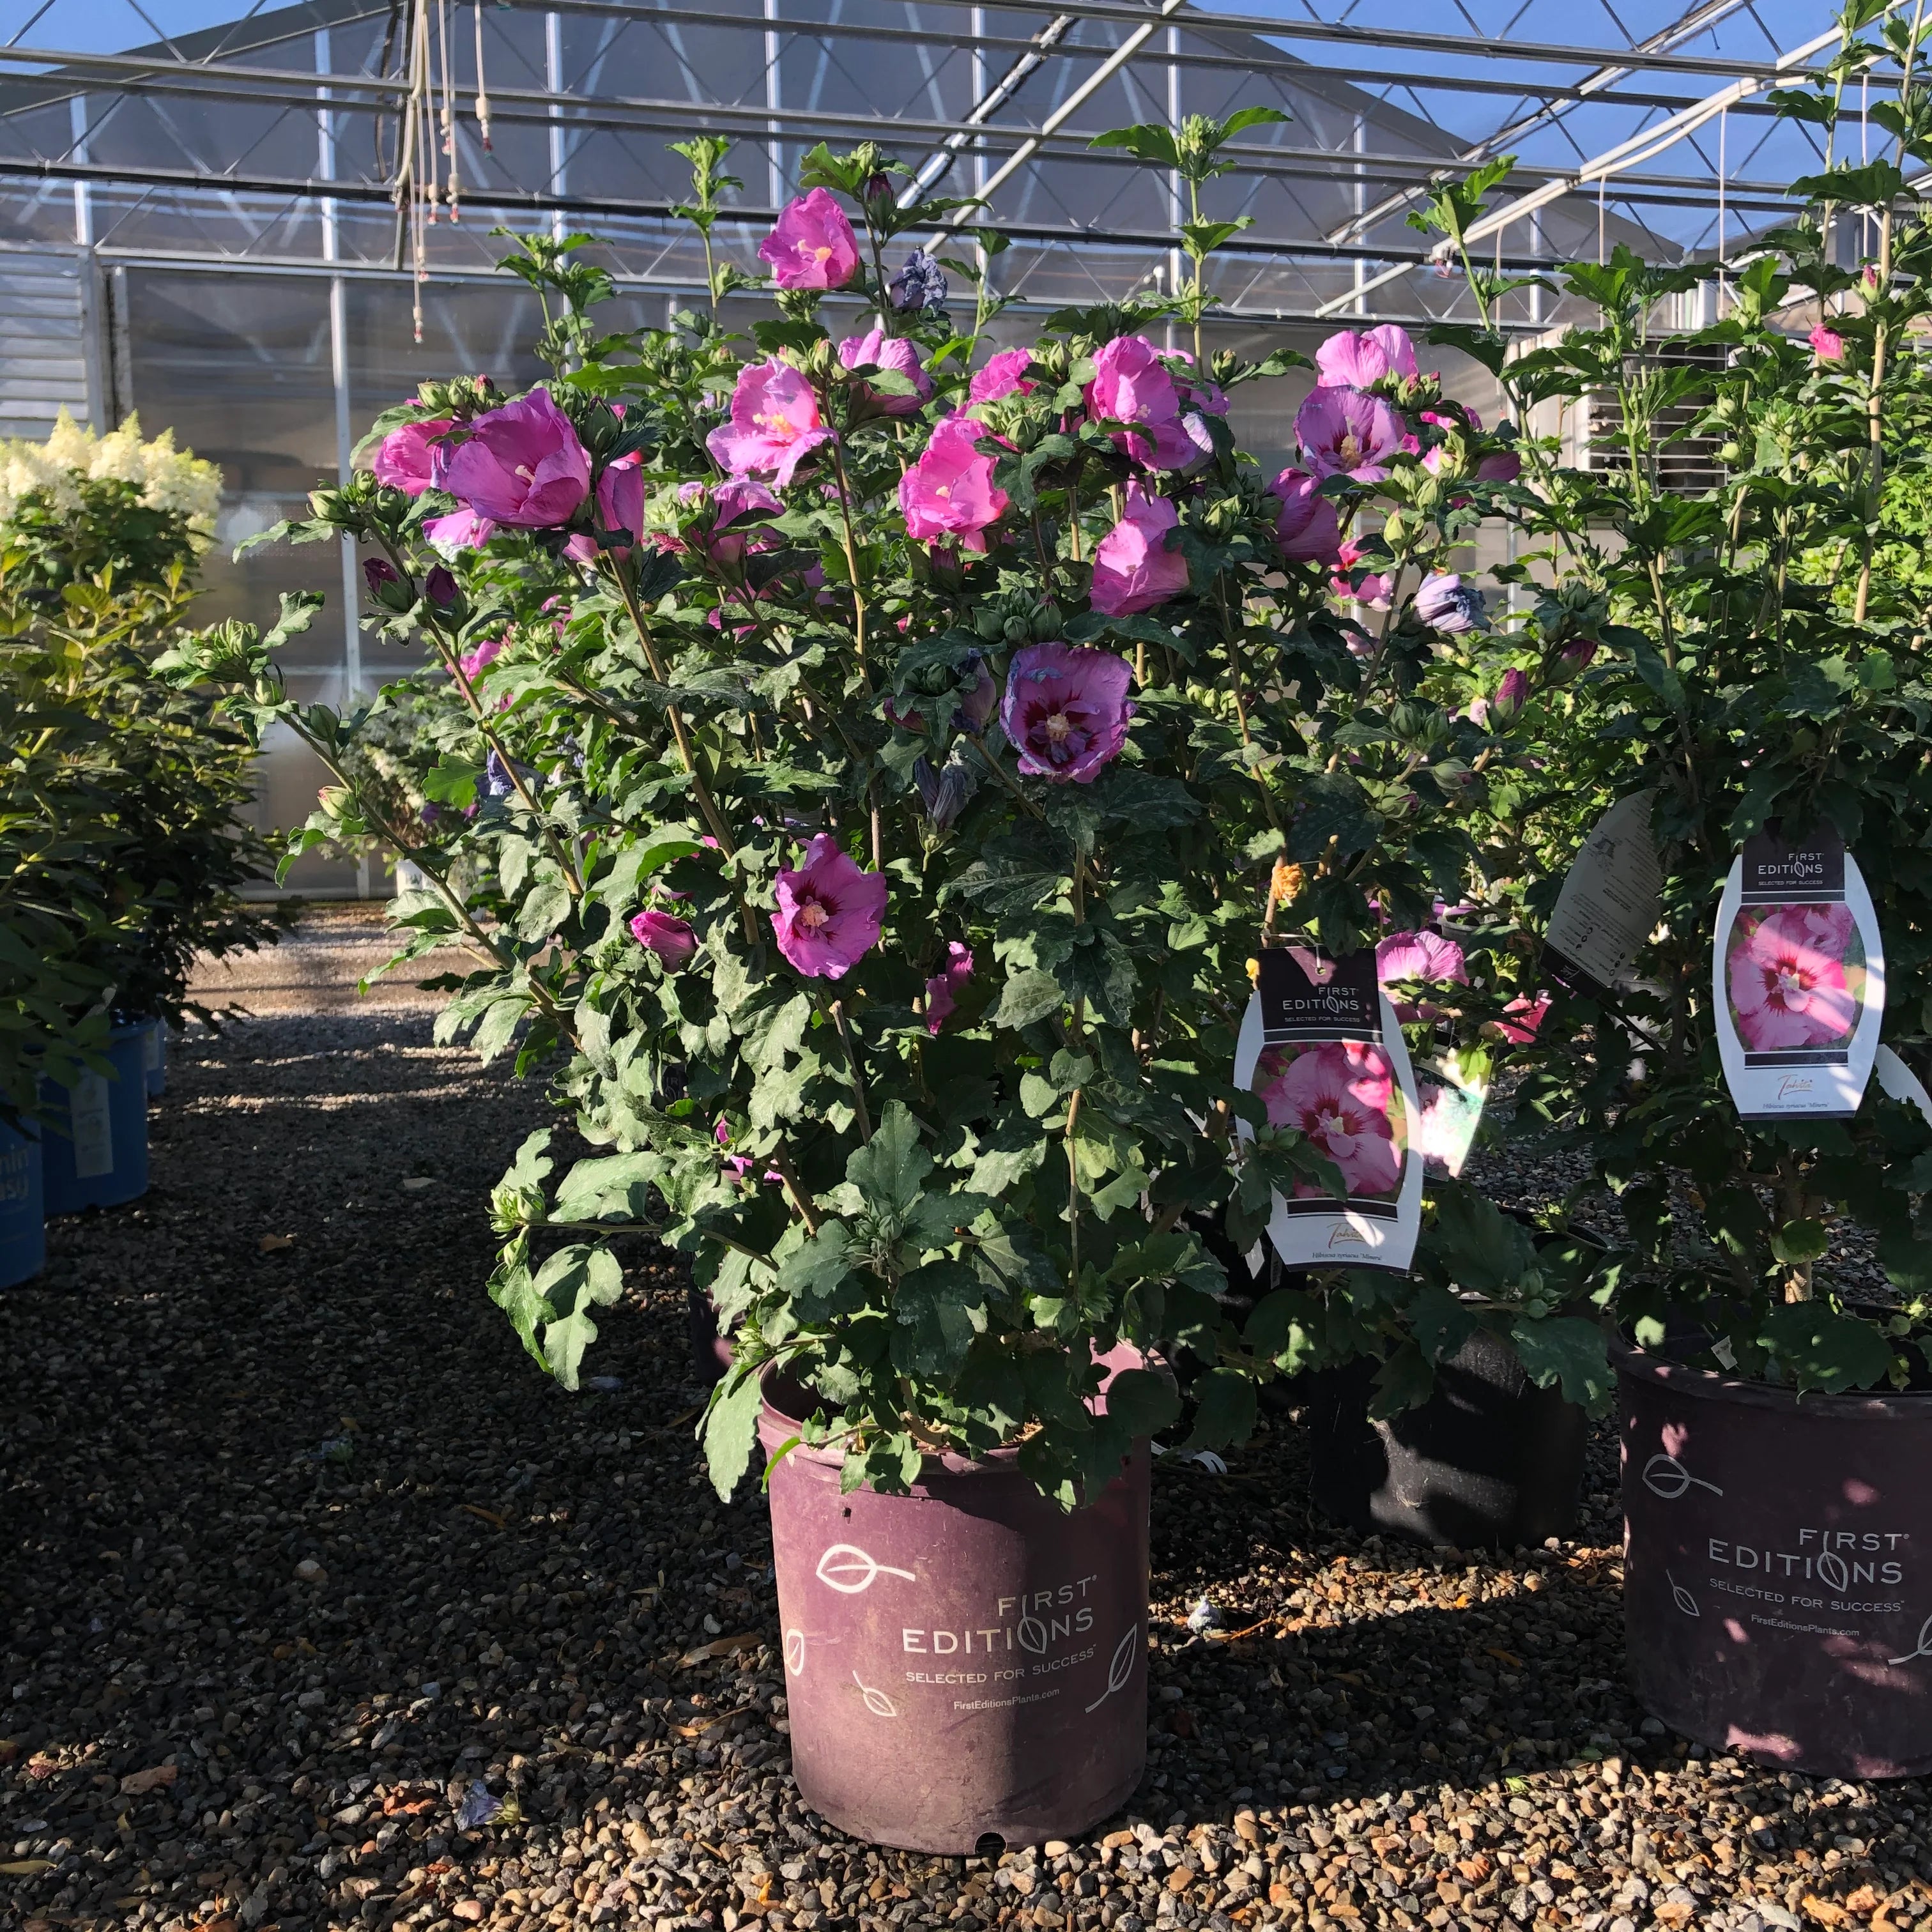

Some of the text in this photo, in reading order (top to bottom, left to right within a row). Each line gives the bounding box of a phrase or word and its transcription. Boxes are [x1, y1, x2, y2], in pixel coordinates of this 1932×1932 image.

[1789, 853, 1822, 862] FIRST
[1758, 862, 1823, 878] EDITIONS
[1318, 987, 1356, 996] FIRST
[1282, 996, 1360, 1013] EDITIONS
[1799, 1528, 1902, 1552] FIRST
[1708, 1538, 1903, 1593] EDITIONS
[998, 1577, 1091, 1618] FIRST
[1709, 1578, 1901, 1612] SELECTED FOR SUCCESS
[902, 1607, 1094, 1655] EDITIONS
[1751, 1614, 1860, 1637] FirstEditionsPlants.com
[906, 1648, 1094, 1684] SELECTED FOR SUCCESS
[954, 1689, 1061, 1710] FirstEditionsPlants.com
